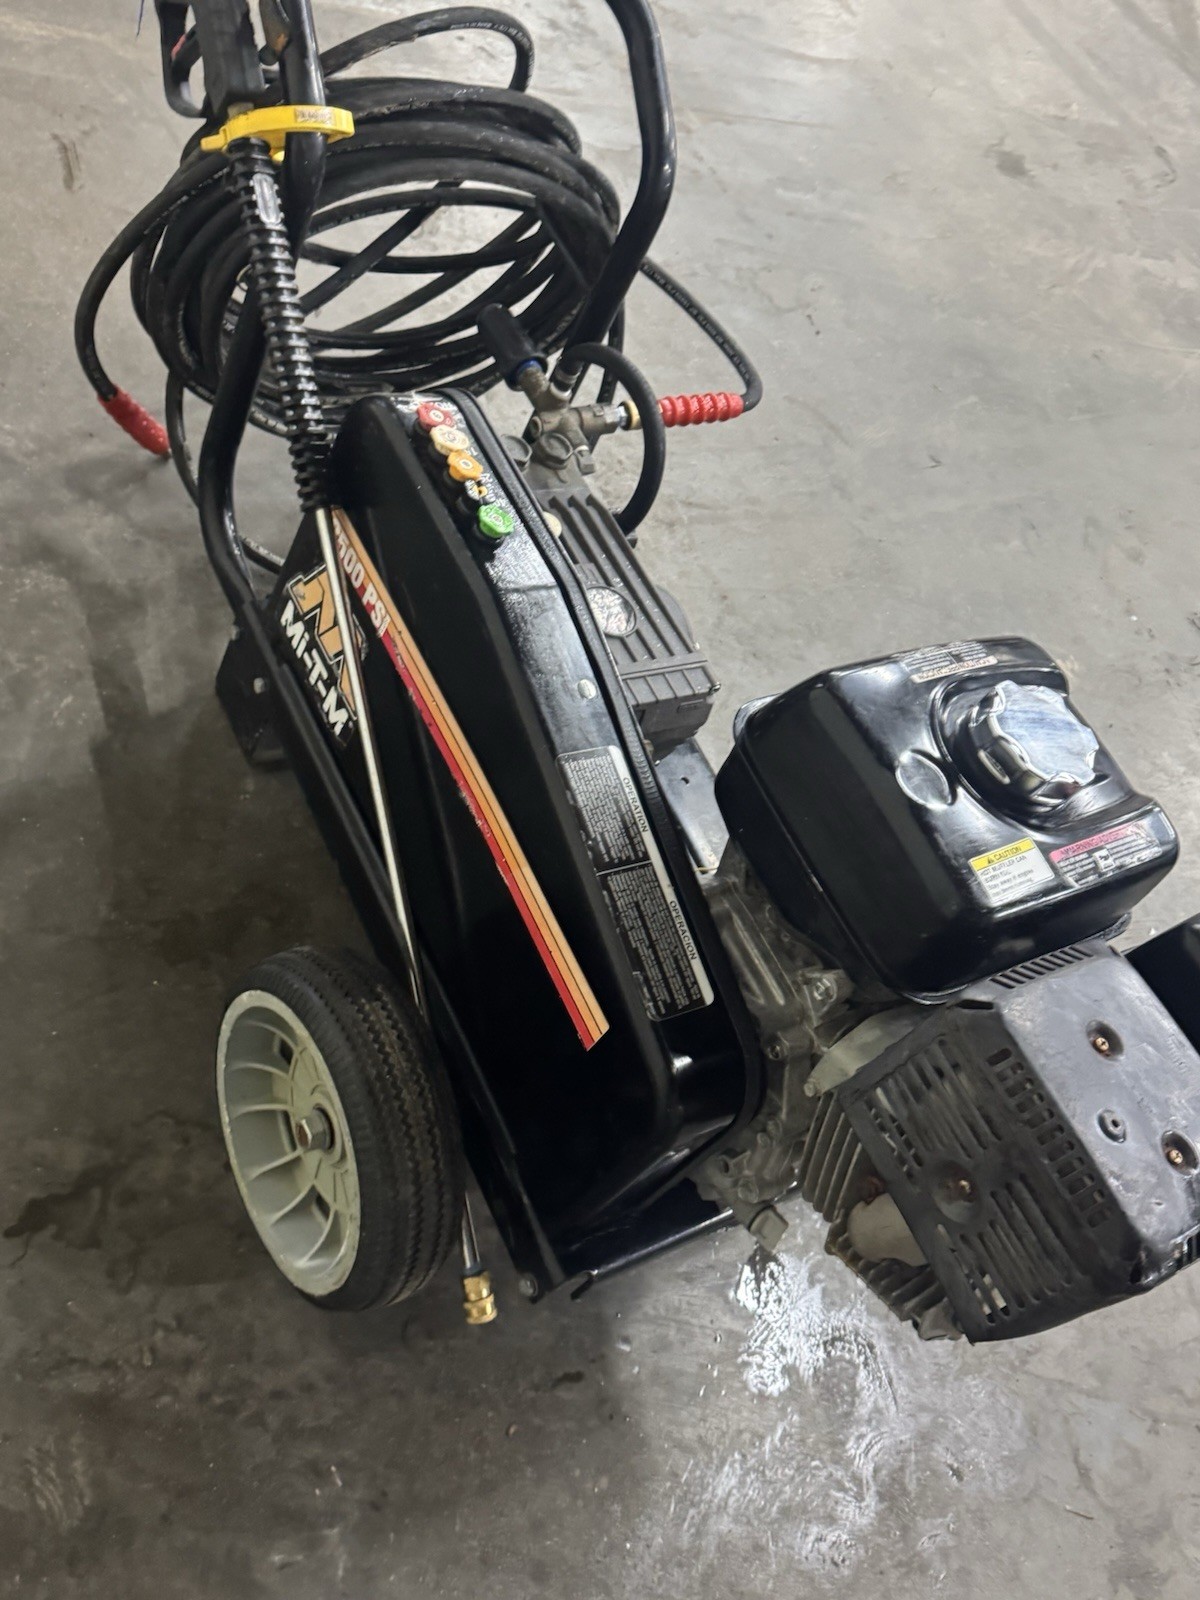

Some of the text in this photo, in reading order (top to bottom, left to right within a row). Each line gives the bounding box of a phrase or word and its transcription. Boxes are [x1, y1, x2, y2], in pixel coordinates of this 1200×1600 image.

[361, 584, 391, 637] PSI
[622, 776, 649, 833] OPERATION
[993, 846, 1022, 861] CAUTION
[669, 900, 698, 961] OPERACION
